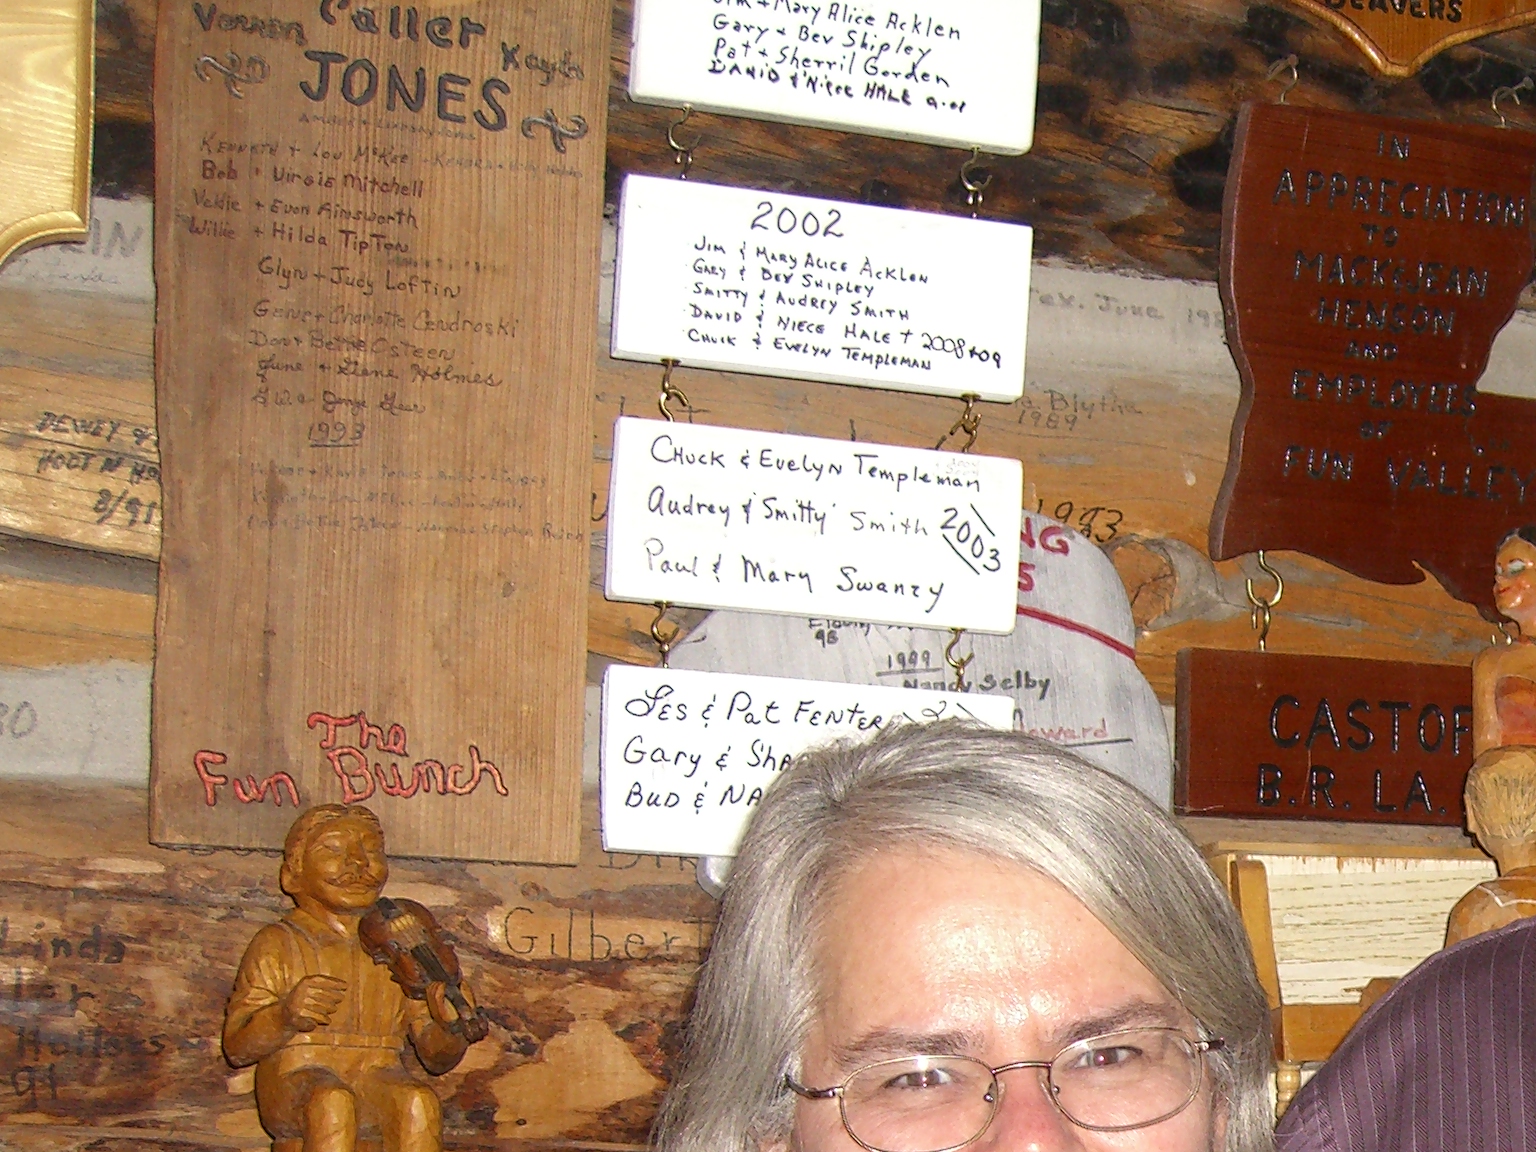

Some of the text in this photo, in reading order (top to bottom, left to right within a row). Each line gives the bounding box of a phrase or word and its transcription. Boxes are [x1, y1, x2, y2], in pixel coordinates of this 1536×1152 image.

[828, 3, 875, 26] Alice
[714, 14, 931, 68] Gary Bev Shipley
[714, 38, 751, 59] Pat
[300, 49, 510, 132] JONES
[1376, 131, 1411, 160] IN
[1272, 168, 1526, 228] APPRECIATION
[751, 202, 843, 237] 2002
[1360, 222, 1400, 248] TO
[693, 258, 726, 279] GARY
[802, 274, 873, 297] SHIPLEY
[756, 247, 797, 269] MARY
[805, 253, 847, 271] ALICE
[693, 282, 748, 307] SMITTY
[851, 301, 908, 320] SMITH
[1318, 296, 1457, 336] HENSON
[689, 304, 965, 359] DAVID NIECE HALE 2008
[1344, 340, 1398, 361] AND
[773, 338, 831, 357] EVELYN
[842, 347, 930, 370] TEMPLEMAN
[1290, 368, 1479, 418] EMPLOYEES
[1358, 419, 1394, 440] OF
[760, 449, 979, 492] Evelyn Templeman
[1281, 443, 1355, 482] FUN
[648, 486, 1001, 572] Audrey Smith 2003
[646, 538, 697, 577] Paul
[742, 555, 812, 593] Mary
[727, 691, 780, 724] Pat
[307, 710, 409, 757] The
[194, 744, 508, 807] Fun Bunch
[624, 735, 701, 777] Gary
[1373, 770, 1447, 815] LA.
